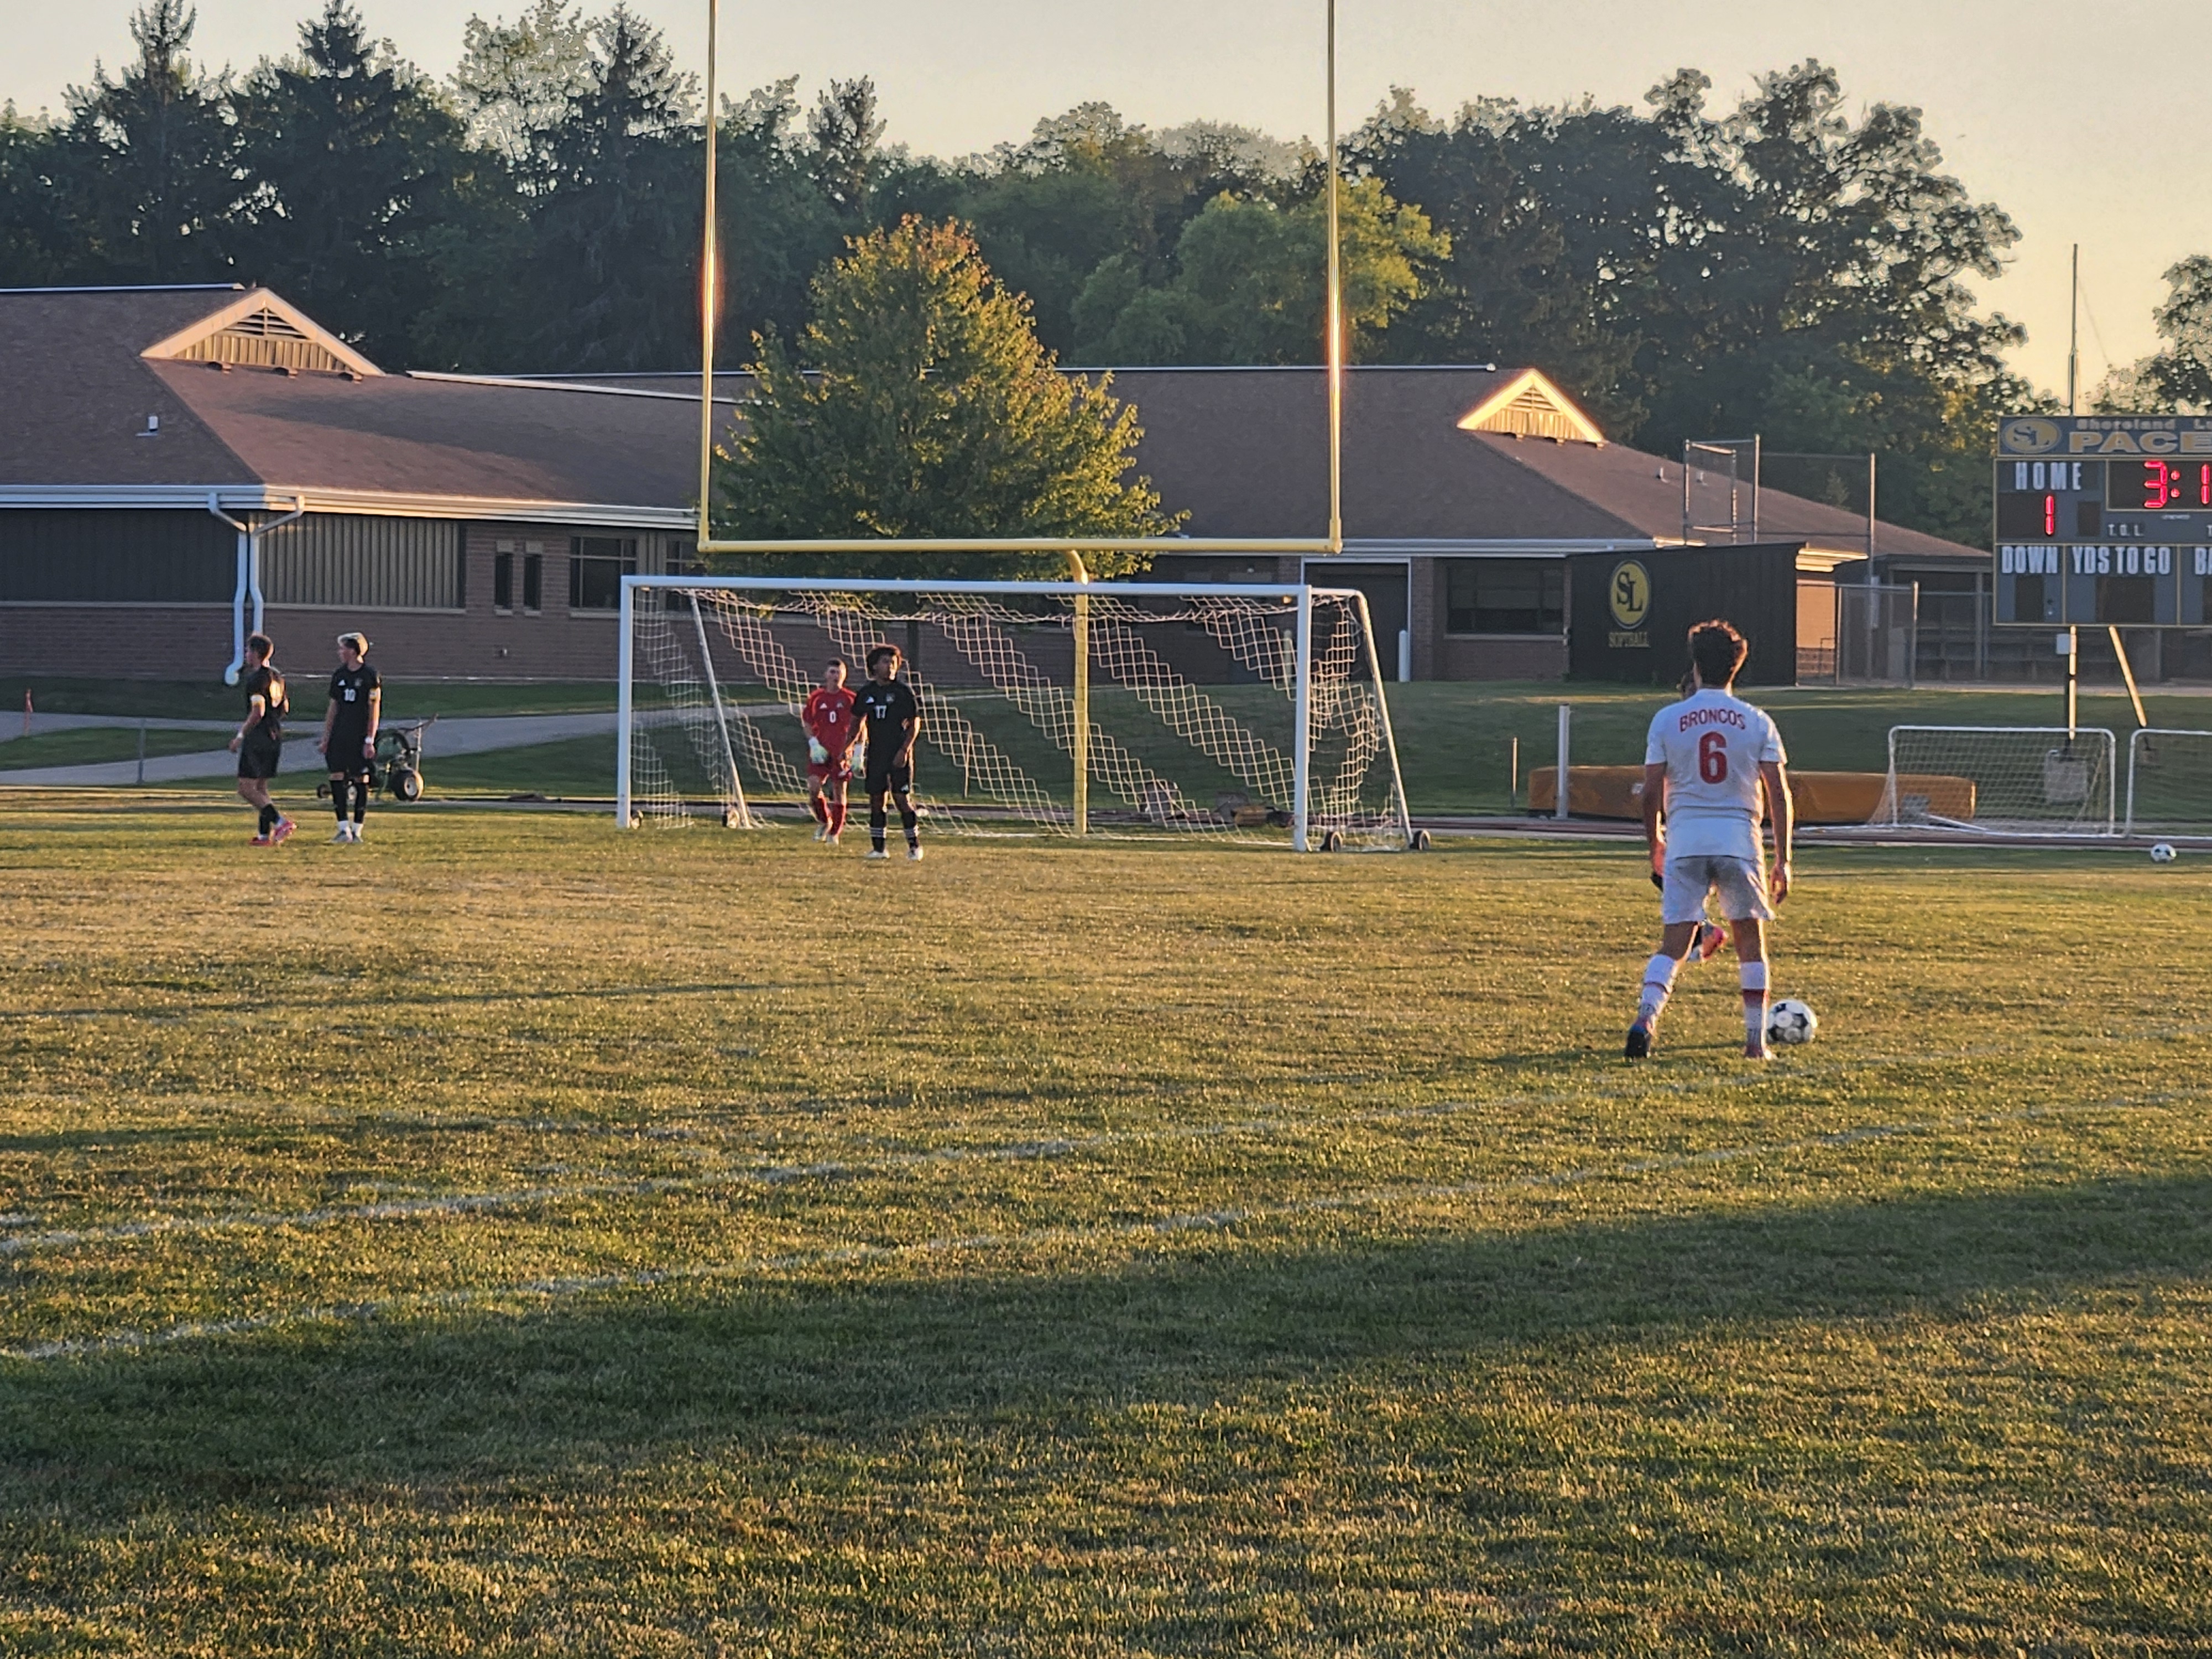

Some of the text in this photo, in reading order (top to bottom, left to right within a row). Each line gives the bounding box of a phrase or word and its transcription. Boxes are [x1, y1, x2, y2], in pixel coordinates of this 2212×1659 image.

[2013, 426, 2050, 446] SL
[2069, 431, 2212, 453] PACE
[2016, 462, 2081, 490] HOME
[2045, 495, 2055, 535] 1
[2002, 546, 2058, 574] DOWN
[2072, 546, 2171, 575] YDS TO GO
[1616, 571, 1643, 612] SL
[344, 688, 356, 701] 10
[830, 711, 836, 723] 0
[875, 705, 887, 718] 17
[1679, 709, 1746, 732] BRONCOS
[1699, 731, 1727, 784] 6
